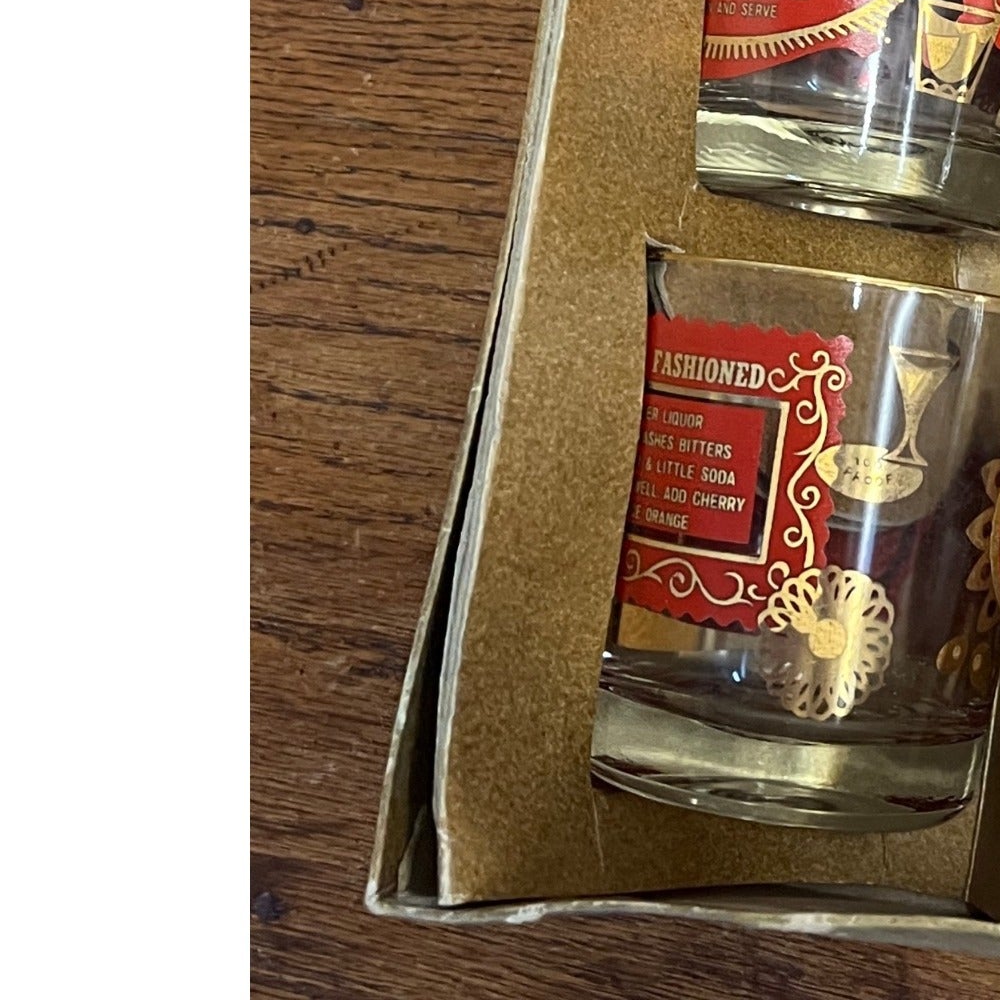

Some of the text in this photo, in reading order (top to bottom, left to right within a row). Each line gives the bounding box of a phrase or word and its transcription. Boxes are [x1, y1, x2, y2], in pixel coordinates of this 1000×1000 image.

[717, 2, 736, 15] AND
[741, 2, 777, 18] SERVE
[651, 349, 766, 389] FASHIONED
[662, 409, 704, 429] LIQUOR
[679, 437, 732, 459] BITTERS
[645, 457, 735, 486] & LITTLE SODA
[663, 486, 687, 504] ADD
[692, 491, 746, 512] CHERRY
[645, 507, 689, 530] ORANGE
